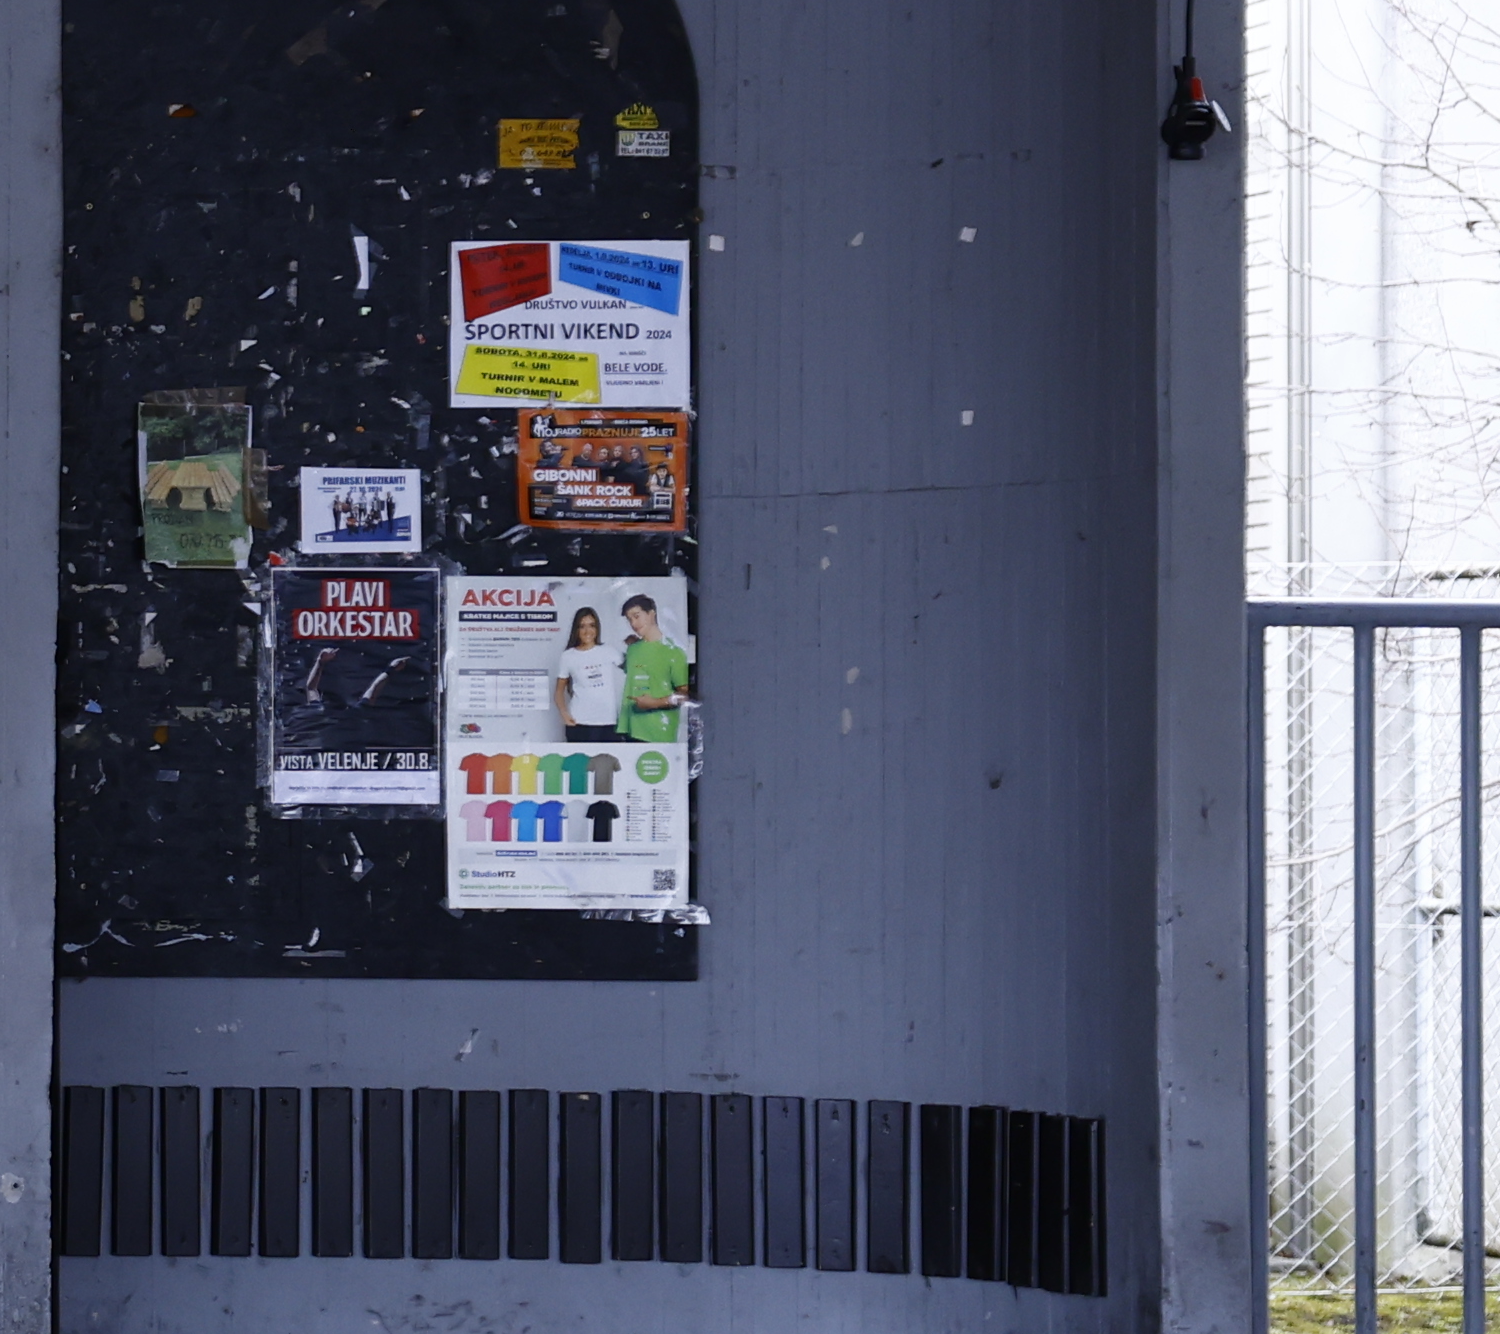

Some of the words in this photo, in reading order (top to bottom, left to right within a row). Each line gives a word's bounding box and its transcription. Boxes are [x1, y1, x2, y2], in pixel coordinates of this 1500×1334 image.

[637, 132, 668, 140] TAXI
[659, 262, 679, 275] URI
[604, 270, 645, 287] ODBOJKI
[647, 279, 662, 291] NA
[525, 299, 578, 310] DRUŠTVO
[581, 300, 626, 309] VULKAN
[464, 321, 554, 340] ŠPORTNI
[562, 323, 640, 340] VIKEND
[646, 330, 672, 339] 2024
[532, 362, 550, 370] URI
[604, 363, 630, 372] BELE
[633, 363, 668, 372] VODE.
[481, 372, 524, 382] TURNIR
[539, 376, 579, 386] MALEM
[495, 387, 562, 398] NOGOMETU
[582, 428, 641, 437] PRAZNUJE
[323, 476, 363, 485] PRIFARSKI
[365, 476, 406, 485] MUZIKANTI
[533, 469, 597, 482] GIBONNI
[557, 482, 592, 495] ŠANK
[596, 486, 633, 496] ROCK
[576, 498, 607, 507] 6PACK
[609, 496, 642, 507] ČUKUR
[327, 581, 384, 607] PLAVI
[462, 589, 556, 607] AKCIJA
[298, 611, 413, 637] ORKESTAR
[280, 754, 314, 770] VISTA
[318, 752, 379, 769] VELENJE
[383, 752, 391, 769] /
[396, 752, 432, 770] 30.8.
[471, 870, 516, 878] StudioHTZ
